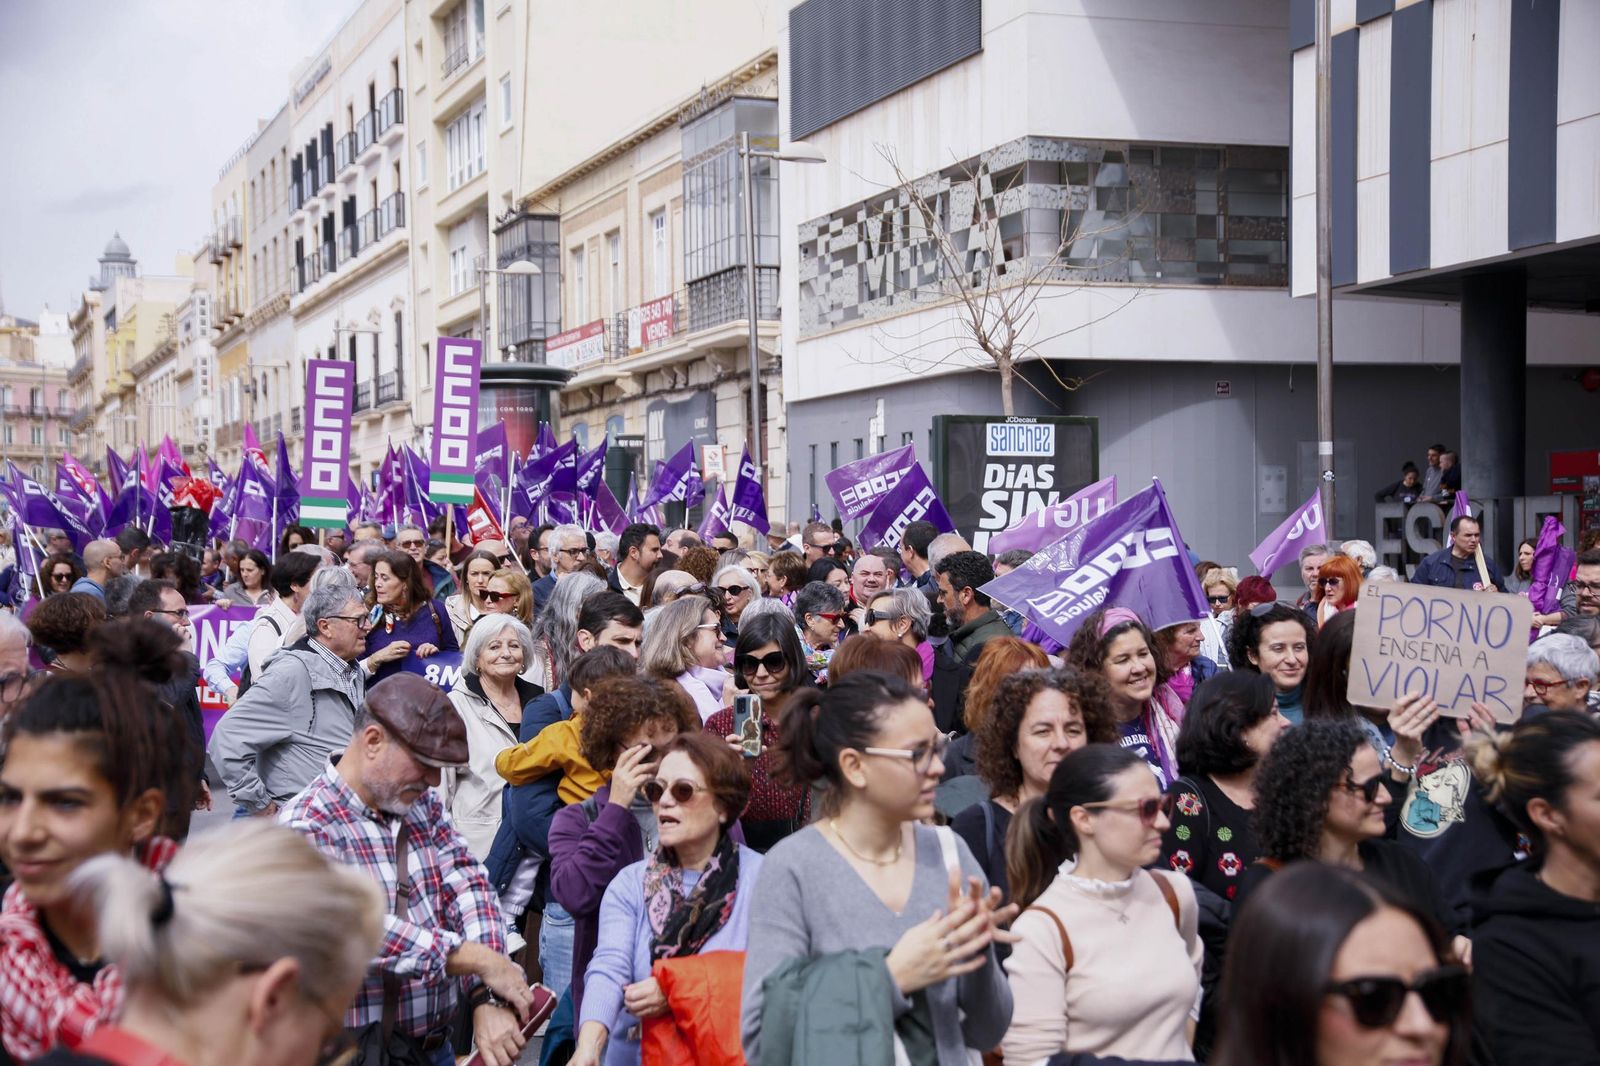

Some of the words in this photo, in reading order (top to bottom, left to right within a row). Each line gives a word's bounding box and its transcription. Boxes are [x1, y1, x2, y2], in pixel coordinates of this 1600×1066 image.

[310, 366, 346, 492] CCOO
[439, 344, 474, 468] CCOO
[1005, 416, 1038, 424] JCDecaux
[1367, 584, 1381, 598] EL
[1378, 594, 1514, 650] PORNO
[1379, 636, 1463, 667] ENSEÑA
[1473, 650, 1490, 671] A
[1361, 658, 1514, 715] VIOLAR
